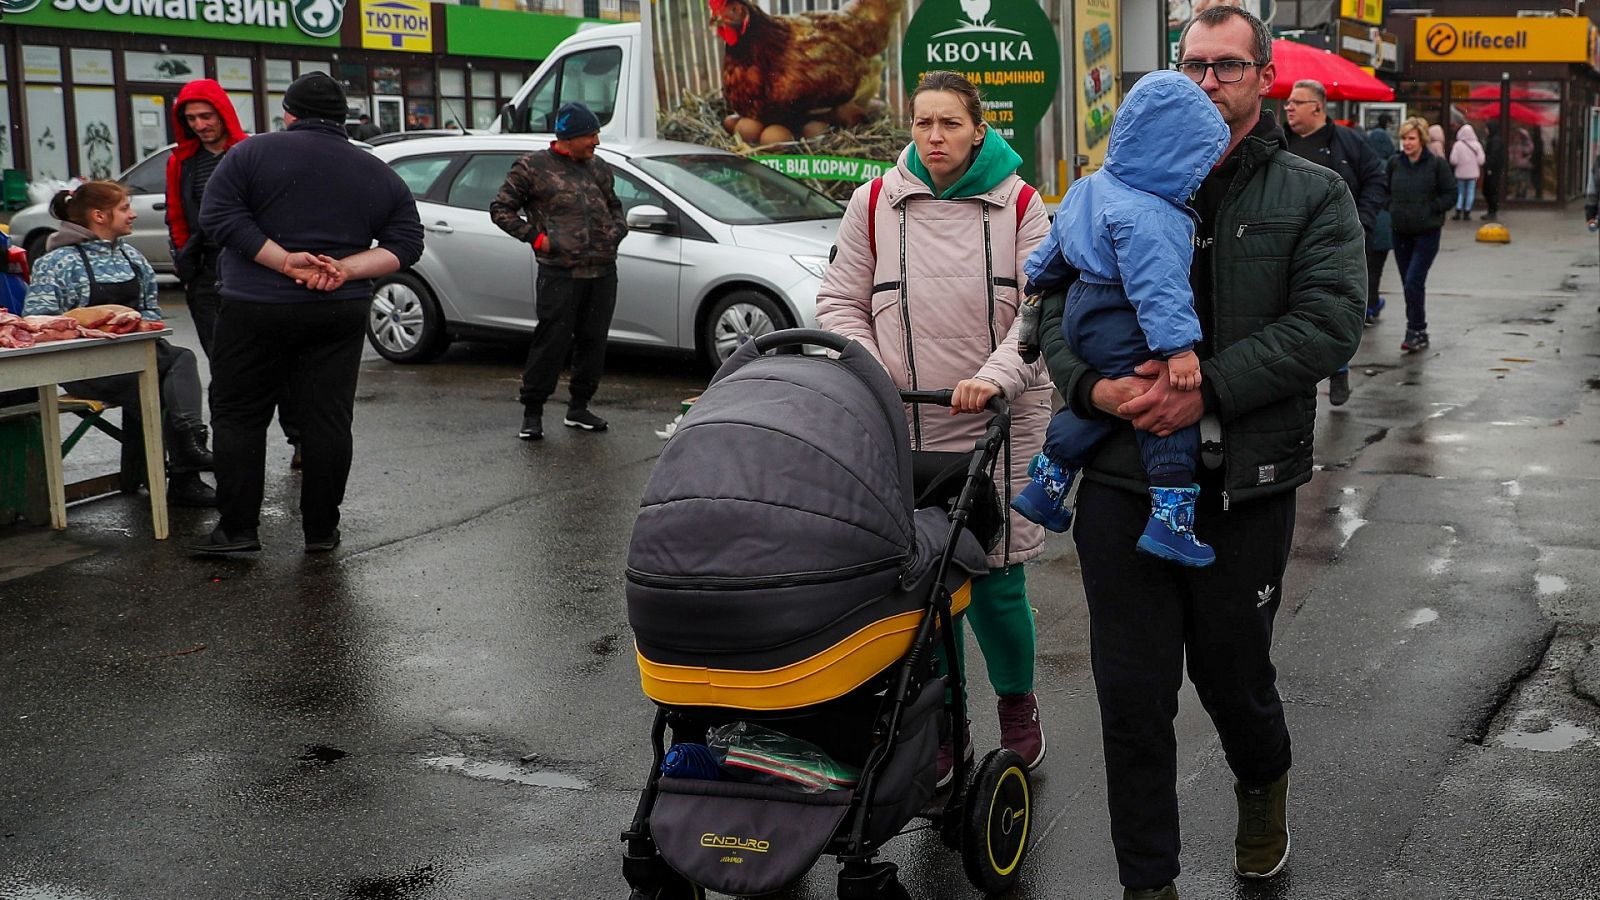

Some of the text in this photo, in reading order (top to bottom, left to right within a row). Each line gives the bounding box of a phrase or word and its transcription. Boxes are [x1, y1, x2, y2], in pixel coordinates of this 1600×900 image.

[366, 12, 429, 31] ТЮТЮН
[1462, 30, 1526, 48] lifecell
[927, 41, 1034, 62] КВОЧКА
[985, 71, 1045, 85] ВІДМІННО!
[786, 159, 809, 175] ВІД
[812, 159, 859, 176] КОРМУ
[861, 164, 881, 180] ДО
[700, 833, 770, 853] ENDURO
